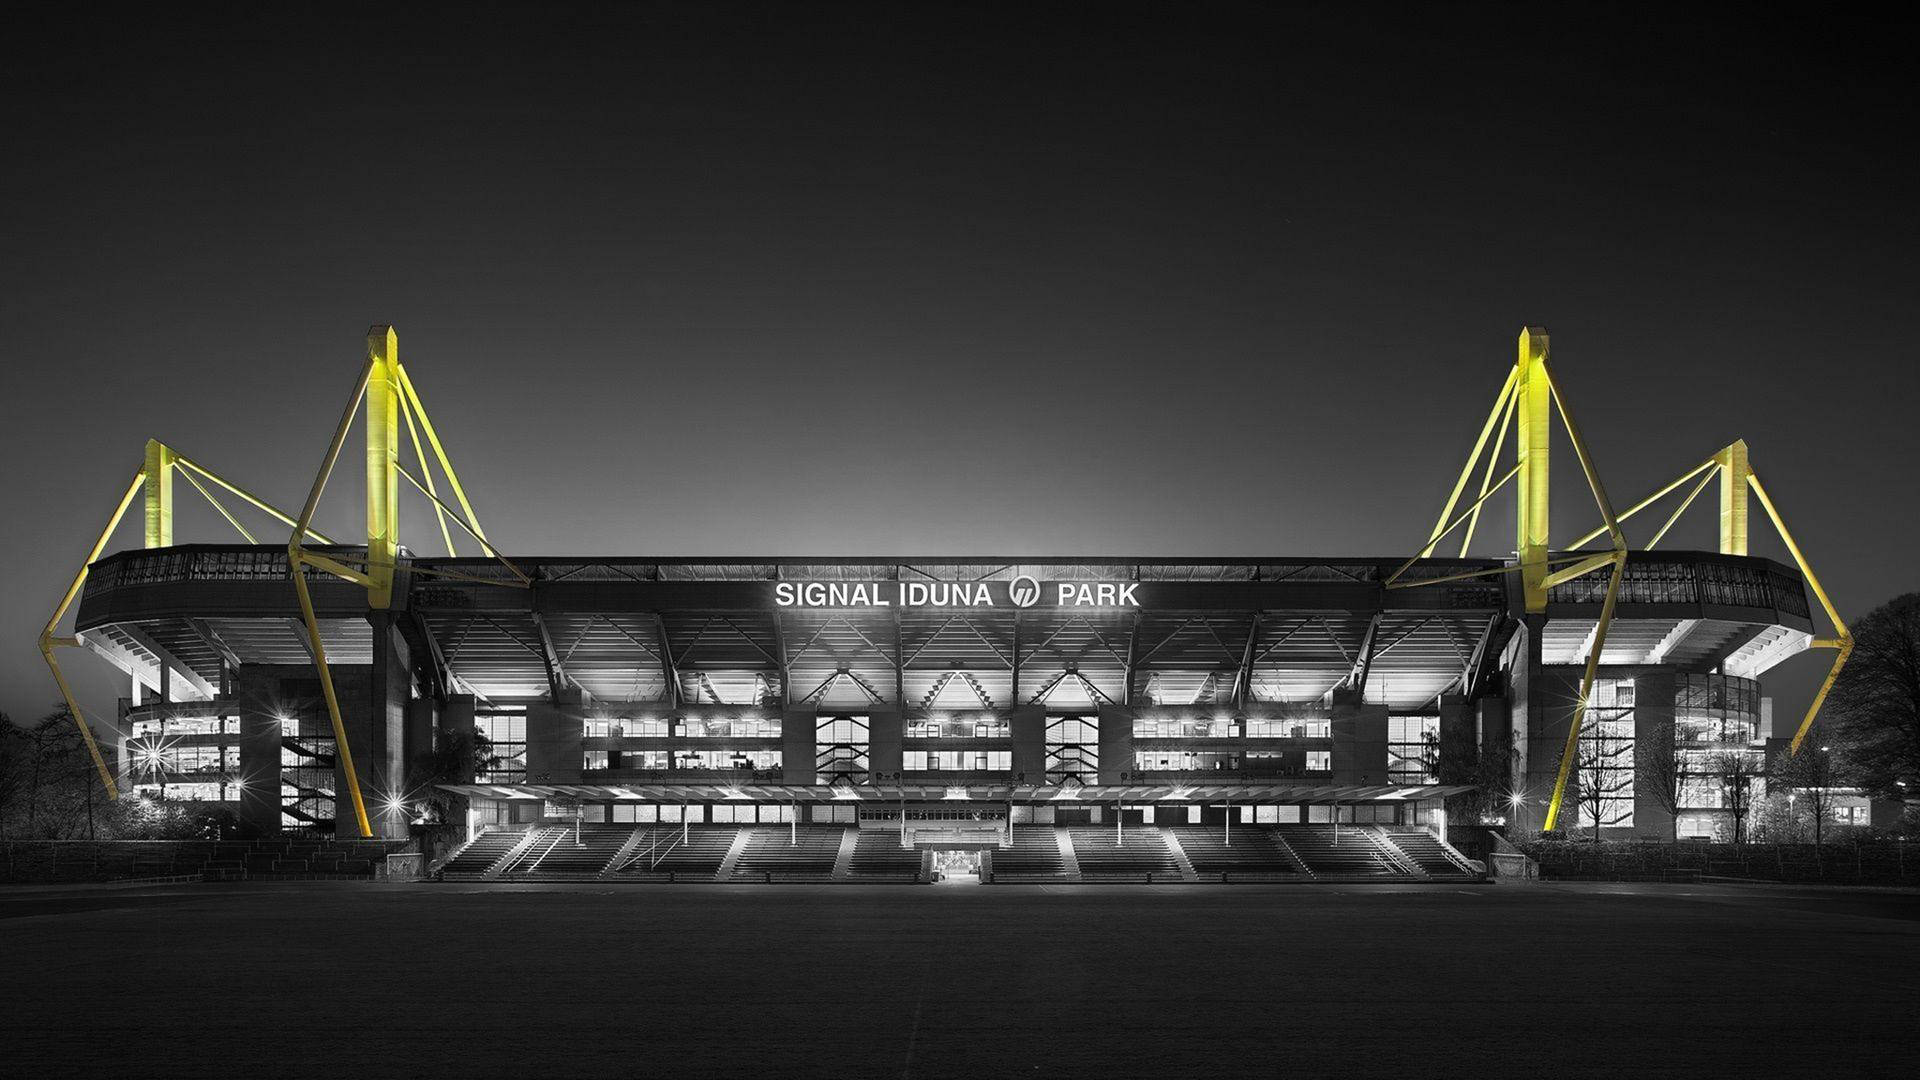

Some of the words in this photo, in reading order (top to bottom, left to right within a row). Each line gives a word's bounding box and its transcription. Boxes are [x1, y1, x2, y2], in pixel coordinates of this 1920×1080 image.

[775, 582, 890, 607] SIGNAL
[900, 583, 994, 606] IDUNA
[1058, 583, 1140, 606] PARK
